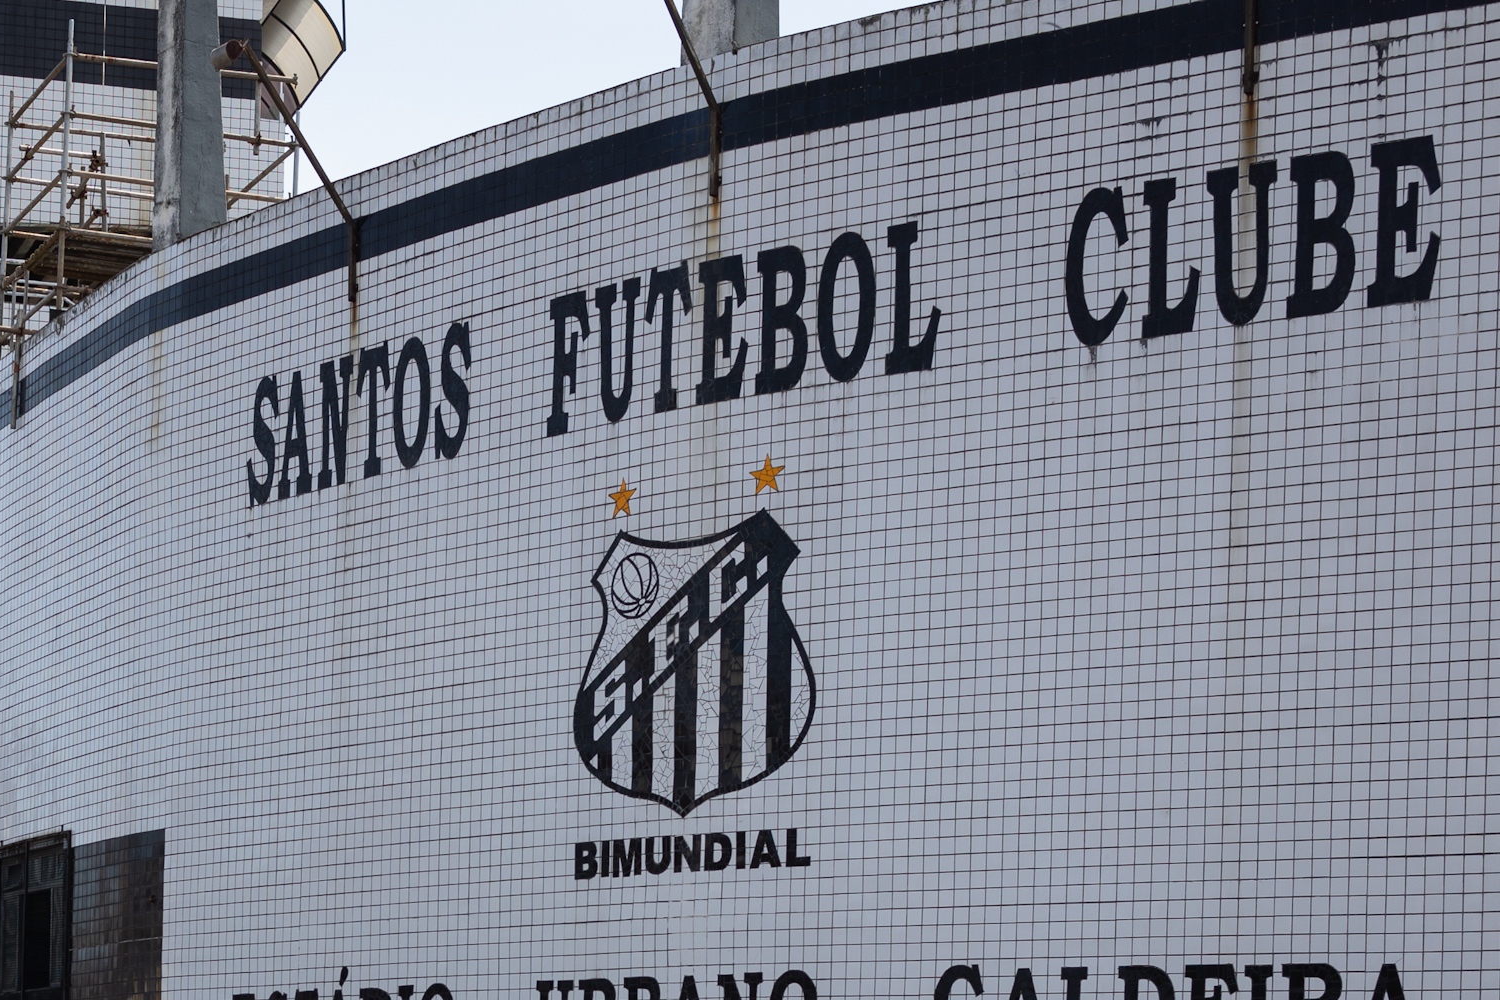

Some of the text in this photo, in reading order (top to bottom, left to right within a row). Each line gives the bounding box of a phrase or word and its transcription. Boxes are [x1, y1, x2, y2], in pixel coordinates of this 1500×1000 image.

[248, 135, 1441, 508] SANTOS FUTEBOL CLUBE
[575, 828, 810, 880] BIMUNDIAL
